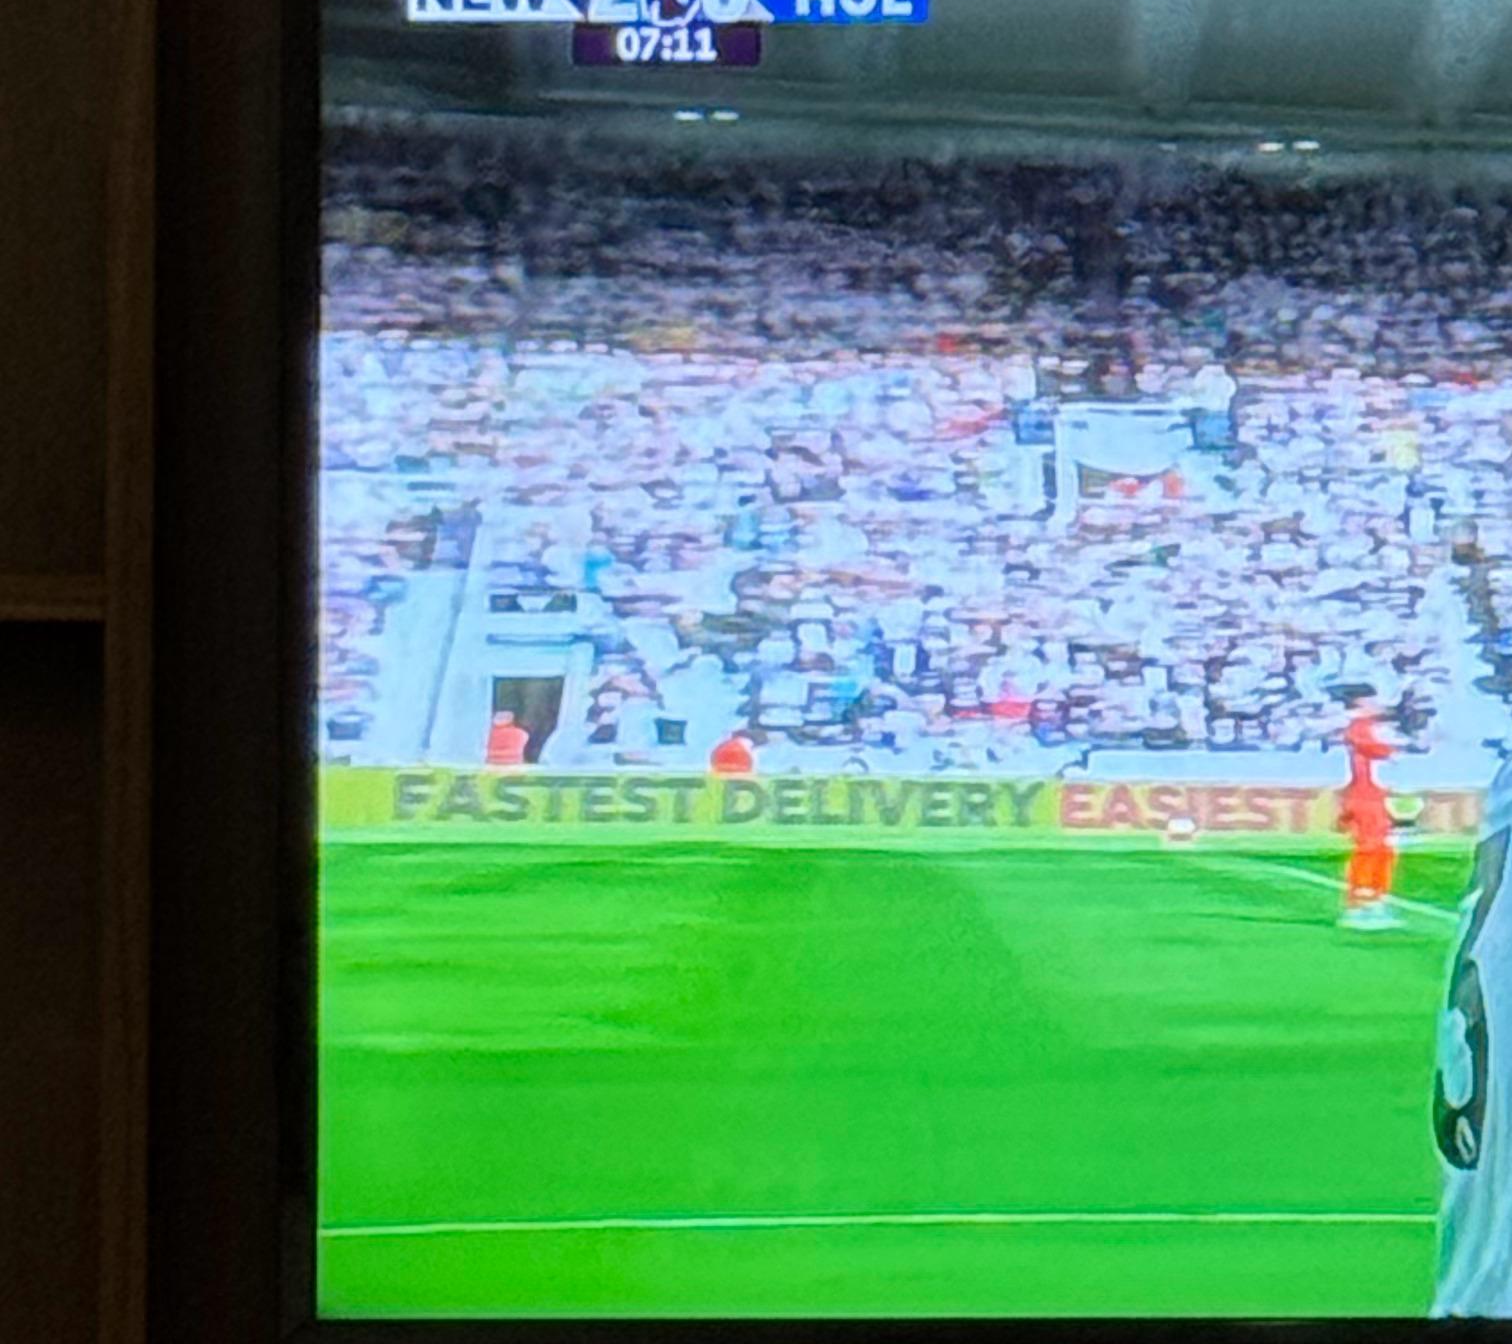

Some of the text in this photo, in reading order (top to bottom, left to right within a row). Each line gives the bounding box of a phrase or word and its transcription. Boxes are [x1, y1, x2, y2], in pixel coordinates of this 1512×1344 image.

[615, 27, 719, 63] 07:11
[393, 771, 706, 823] FASTEST
[720, 775, 1045, 828] DELIVERY
[1059, 783, 1318, 831] EASIEST
